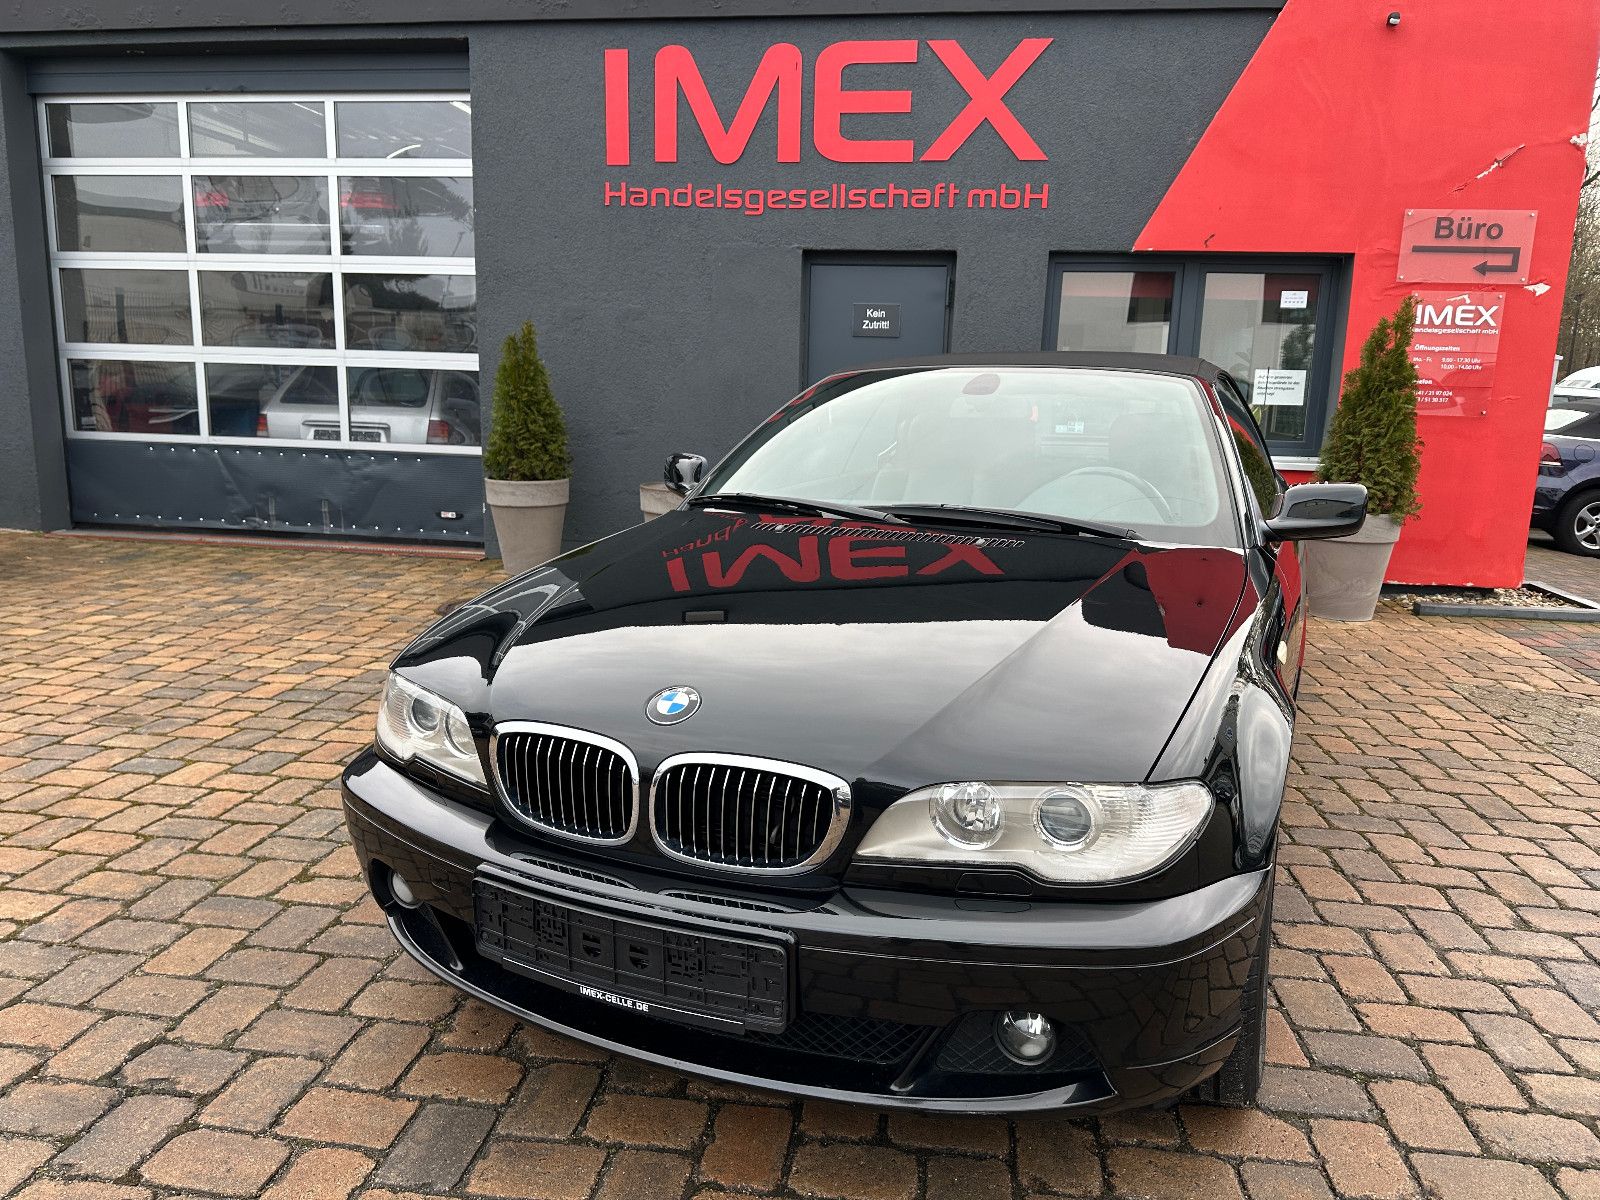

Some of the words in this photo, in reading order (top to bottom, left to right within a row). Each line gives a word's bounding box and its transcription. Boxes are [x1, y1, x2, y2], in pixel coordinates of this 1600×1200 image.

[604, 38, 1054, 165] IMEX
[604, 182, 960, 215] Handelsgesellschaft
[967, 183, 1049, 209] mbH
[1434, 216, 1504, 240] Büro
[862, 319, 890, 329] Zutritt!
[866, 308, 886, 318] Kein
[1415, 304, 1499, 326] IMEX
[1414, 343, 1460, 352] Öffnungszeiten
[580, 985, 649, 1012] IMEX-CELLE.DE
